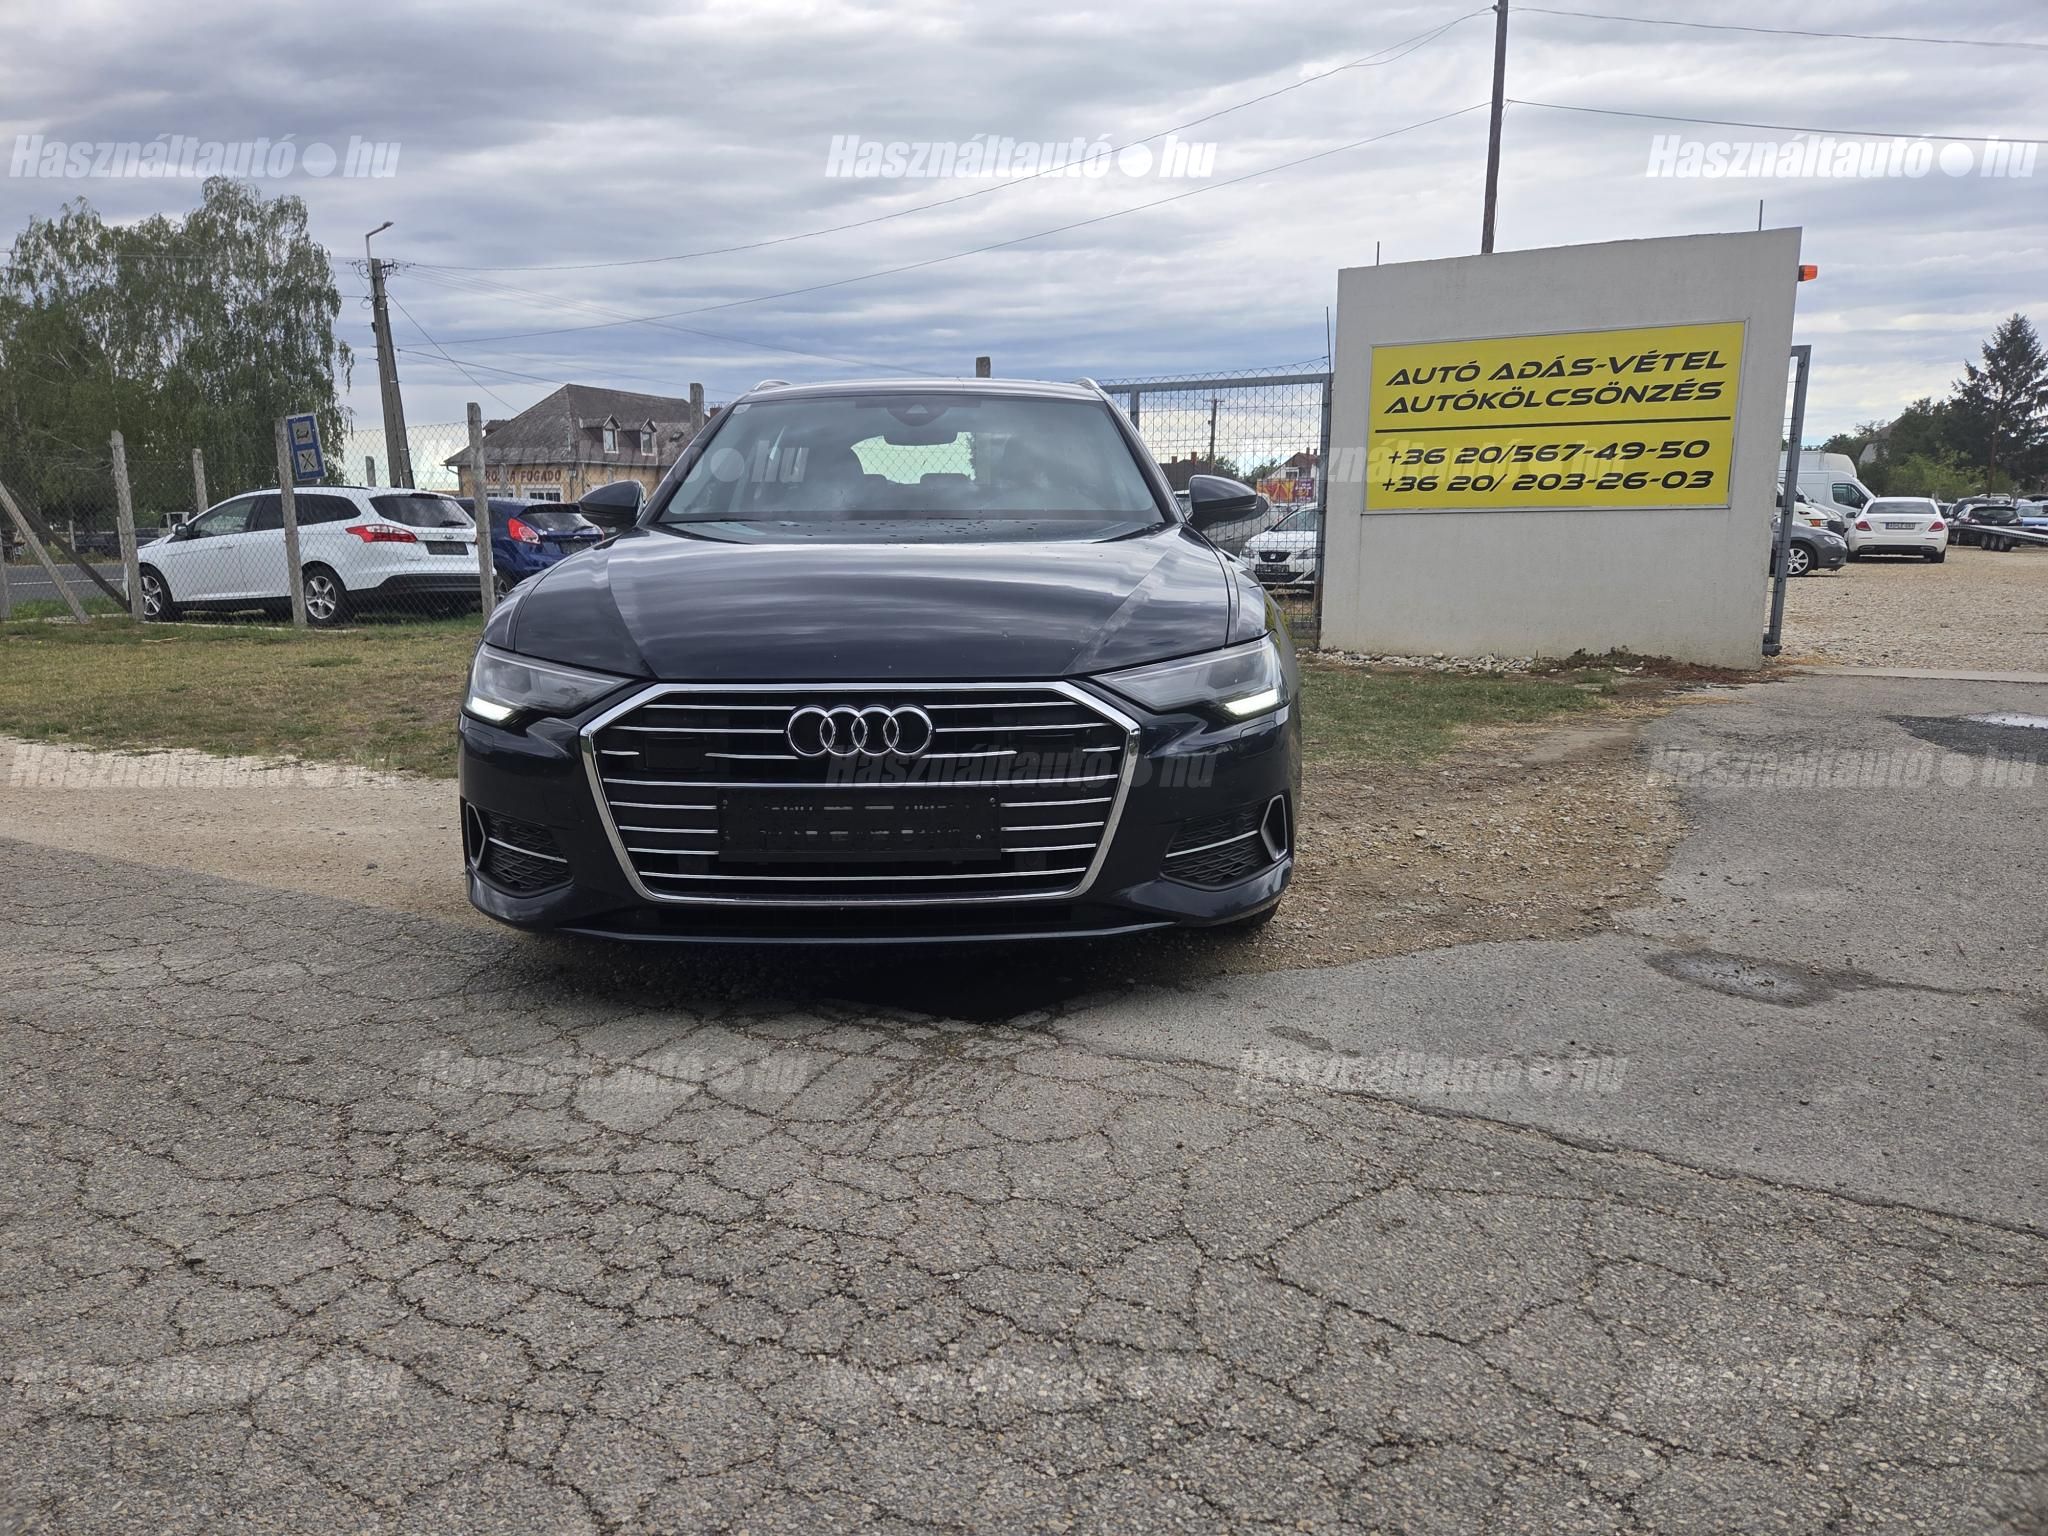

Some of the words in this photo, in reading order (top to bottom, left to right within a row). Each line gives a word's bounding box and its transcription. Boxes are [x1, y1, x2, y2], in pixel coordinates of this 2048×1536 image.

[1385, 361, 1481, 386] AUTÓ
[1487, 350, 1728, 381] ADÁS-VÉTEL
[1384, 378, 1725, 414] AUTÓKÖLCSÖNZÉS
[1388, 448, 1447, 465] +36
[1454, 440, 1710, 465] 20/567-49-50
[1382, 475, 1440, 492] +36
[1446, 474, 1508, 492] 20/
[1511, 470, 1714, 491] 203-26-03
